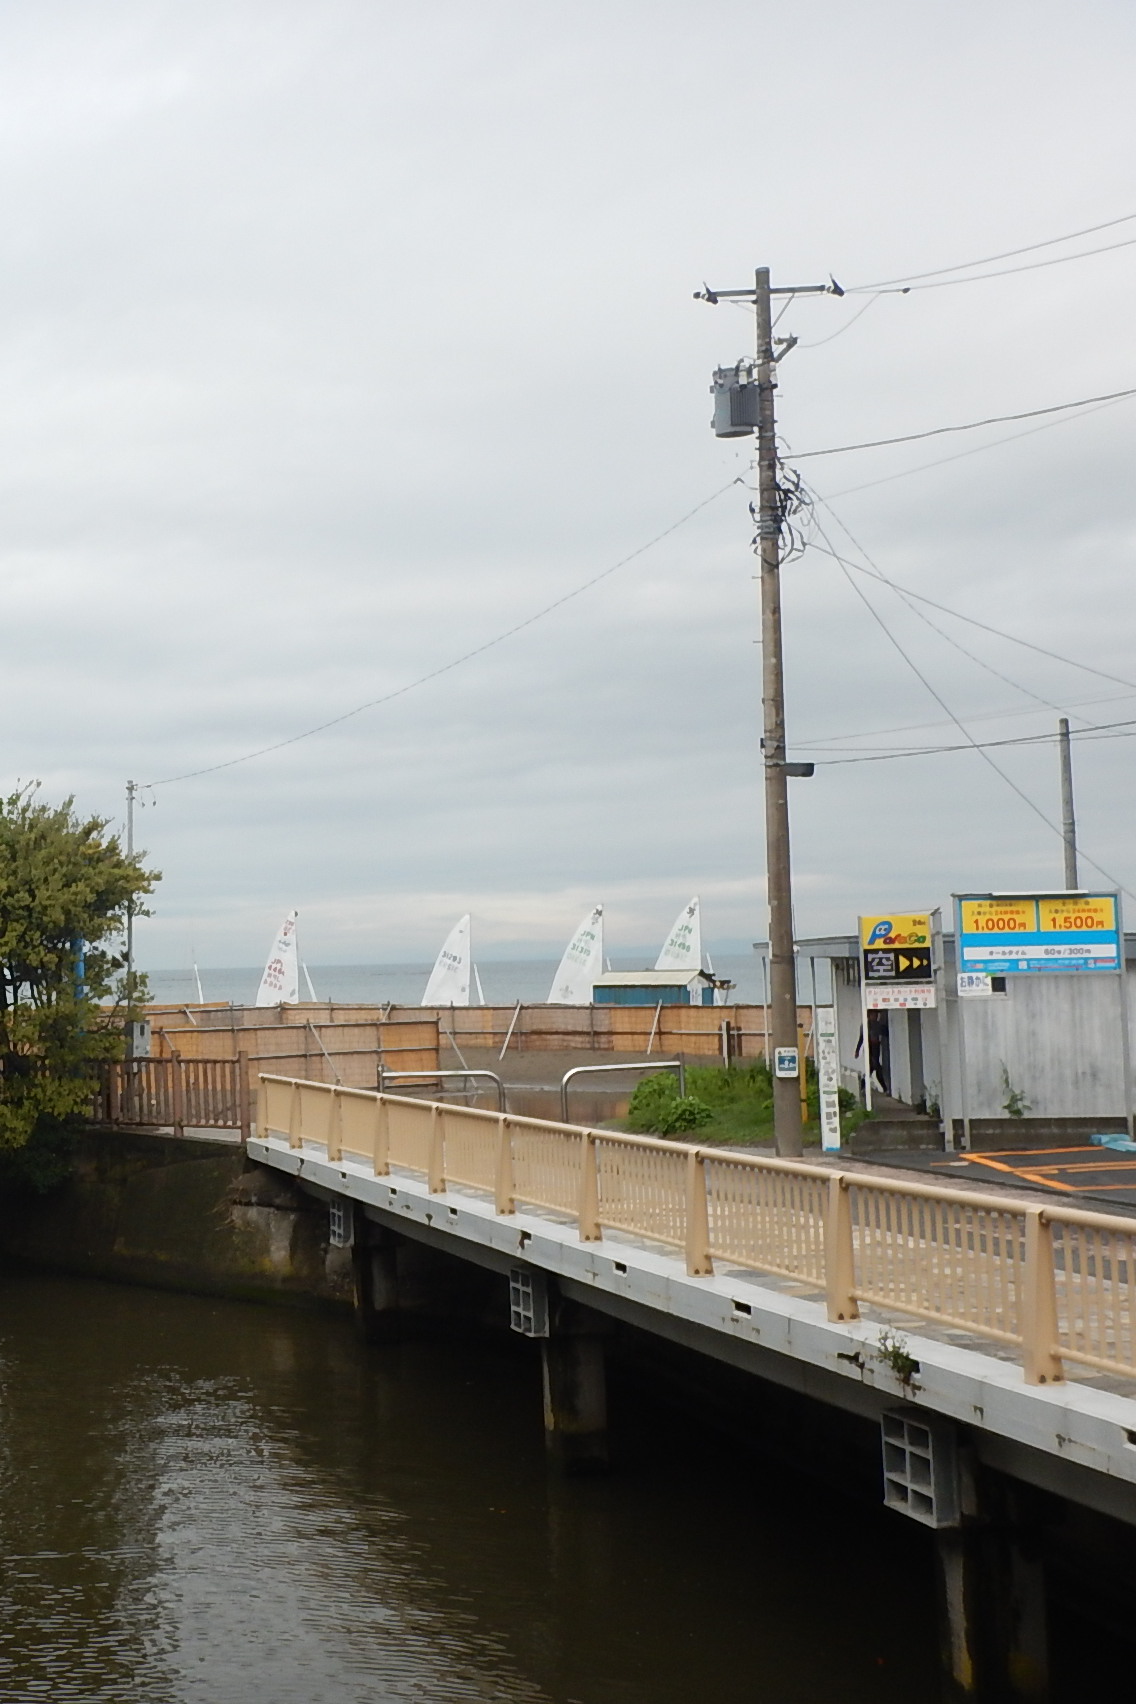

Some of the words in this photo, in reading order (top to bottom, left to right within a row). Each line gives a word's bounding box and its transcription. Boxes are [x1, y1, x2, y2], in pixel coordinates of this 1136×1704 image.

[973, 917, 1027, 931] 1,000円
[1051, 915, 1104, 929] 1,500円
[867, 950, 896, 978] 空
